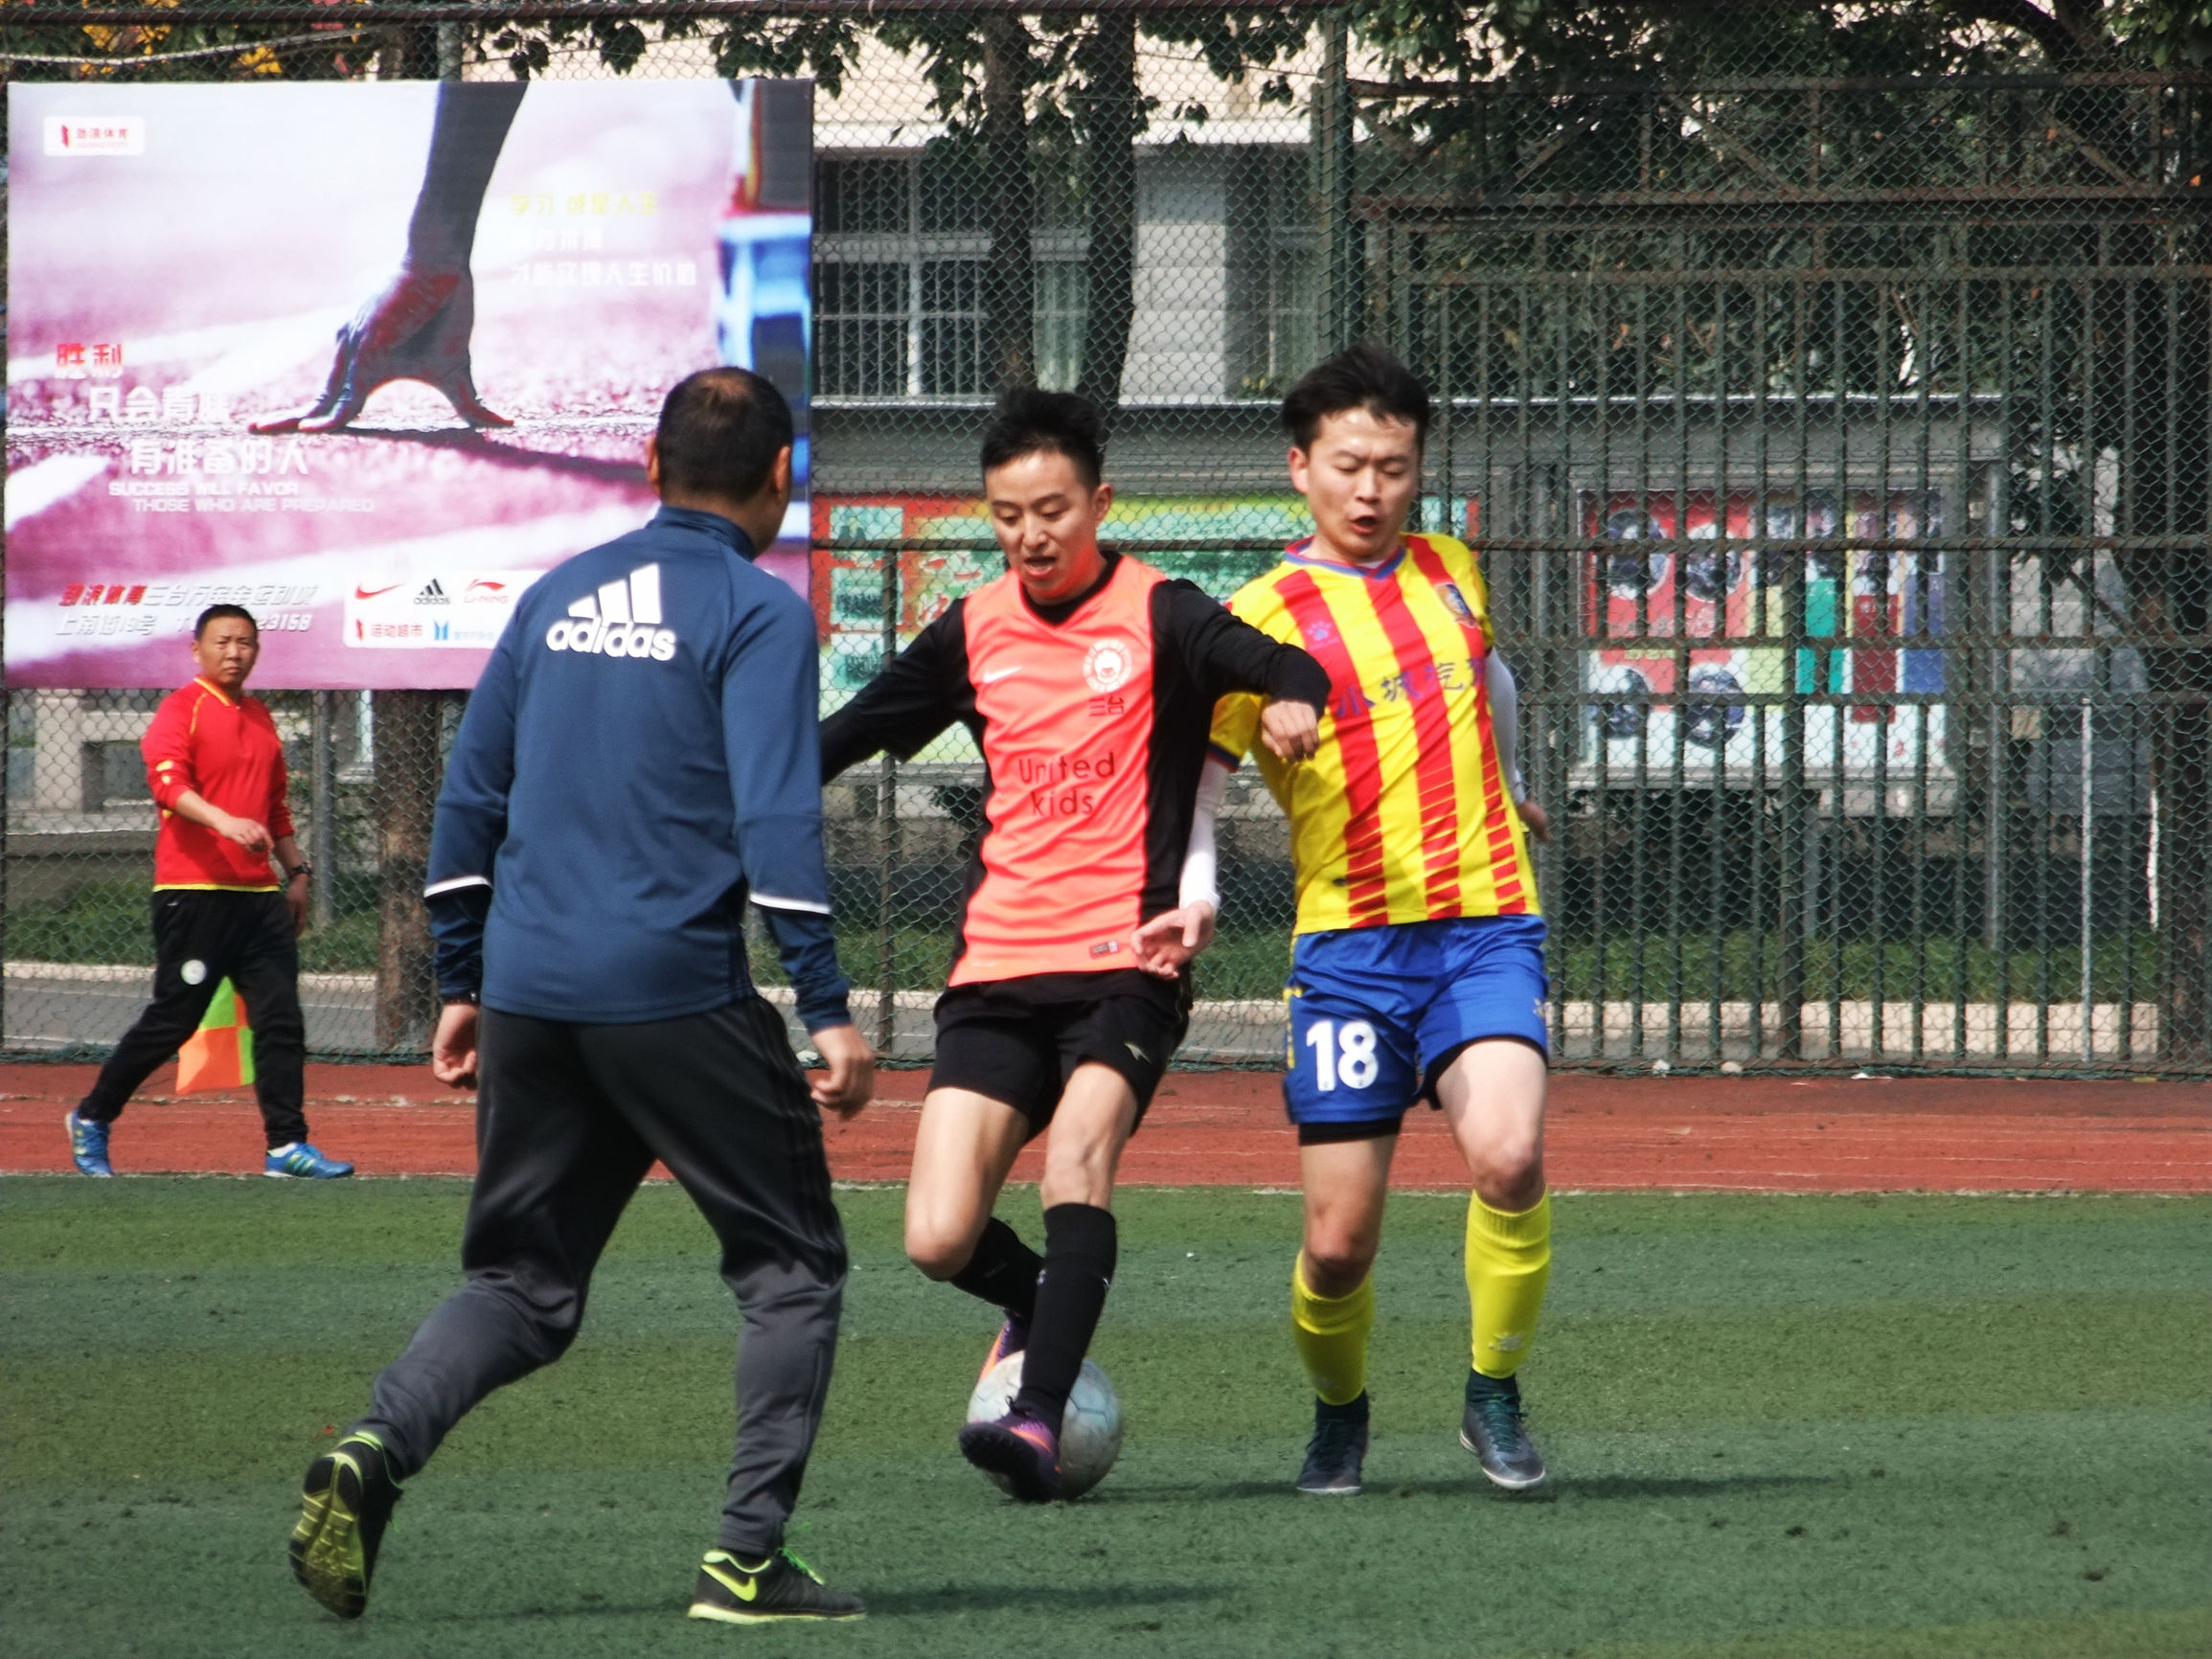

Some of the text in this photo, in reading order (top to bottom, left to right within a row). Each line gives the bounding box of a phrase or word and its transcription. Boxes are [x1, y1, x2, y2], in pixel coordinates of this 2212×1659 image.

[56, 342, 124, 368] 胜利
[129, 438, 309, 475] 有准备的人
[108, 482, 300, 496] SUCCESS WILL FAVOR
[133, 498, 376, 512] THOSE WHO ARE PREPARED
[545, 615, 677, 662] adidas
[1087, 694, 1125, 717] 三台
[1018, 751, 1116, 784] United
[1031, 789, 1094, 818] kids
[1306, 1019, 1379, 1091] 18
